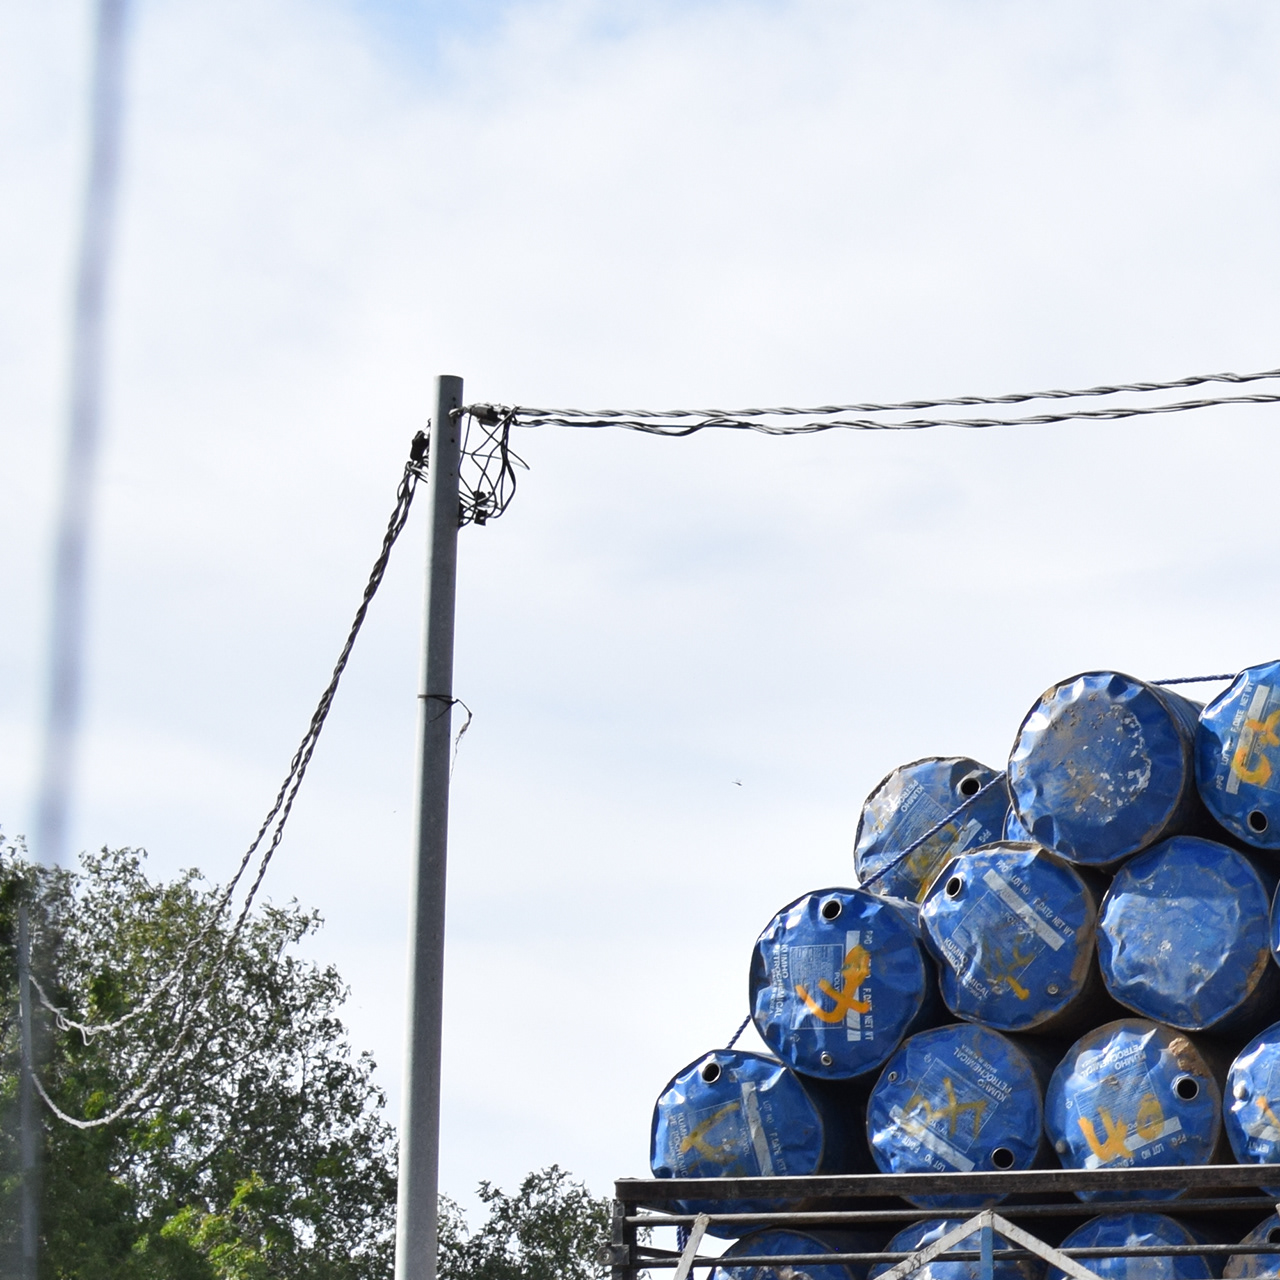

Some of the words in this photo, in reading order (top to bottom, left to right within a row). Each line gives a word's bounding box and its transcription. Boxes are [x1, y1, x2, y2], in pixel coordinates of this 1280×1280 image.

[900, 784, 925, 813] KUMHO
[944, 937, 969, 963] KUMHO
[954, 1046, 1013, 1096] PETROCHEMICAL
[977, 1078, 1007, 1103] KUMHO
[677, 1112, 688, 1142] KUMH
